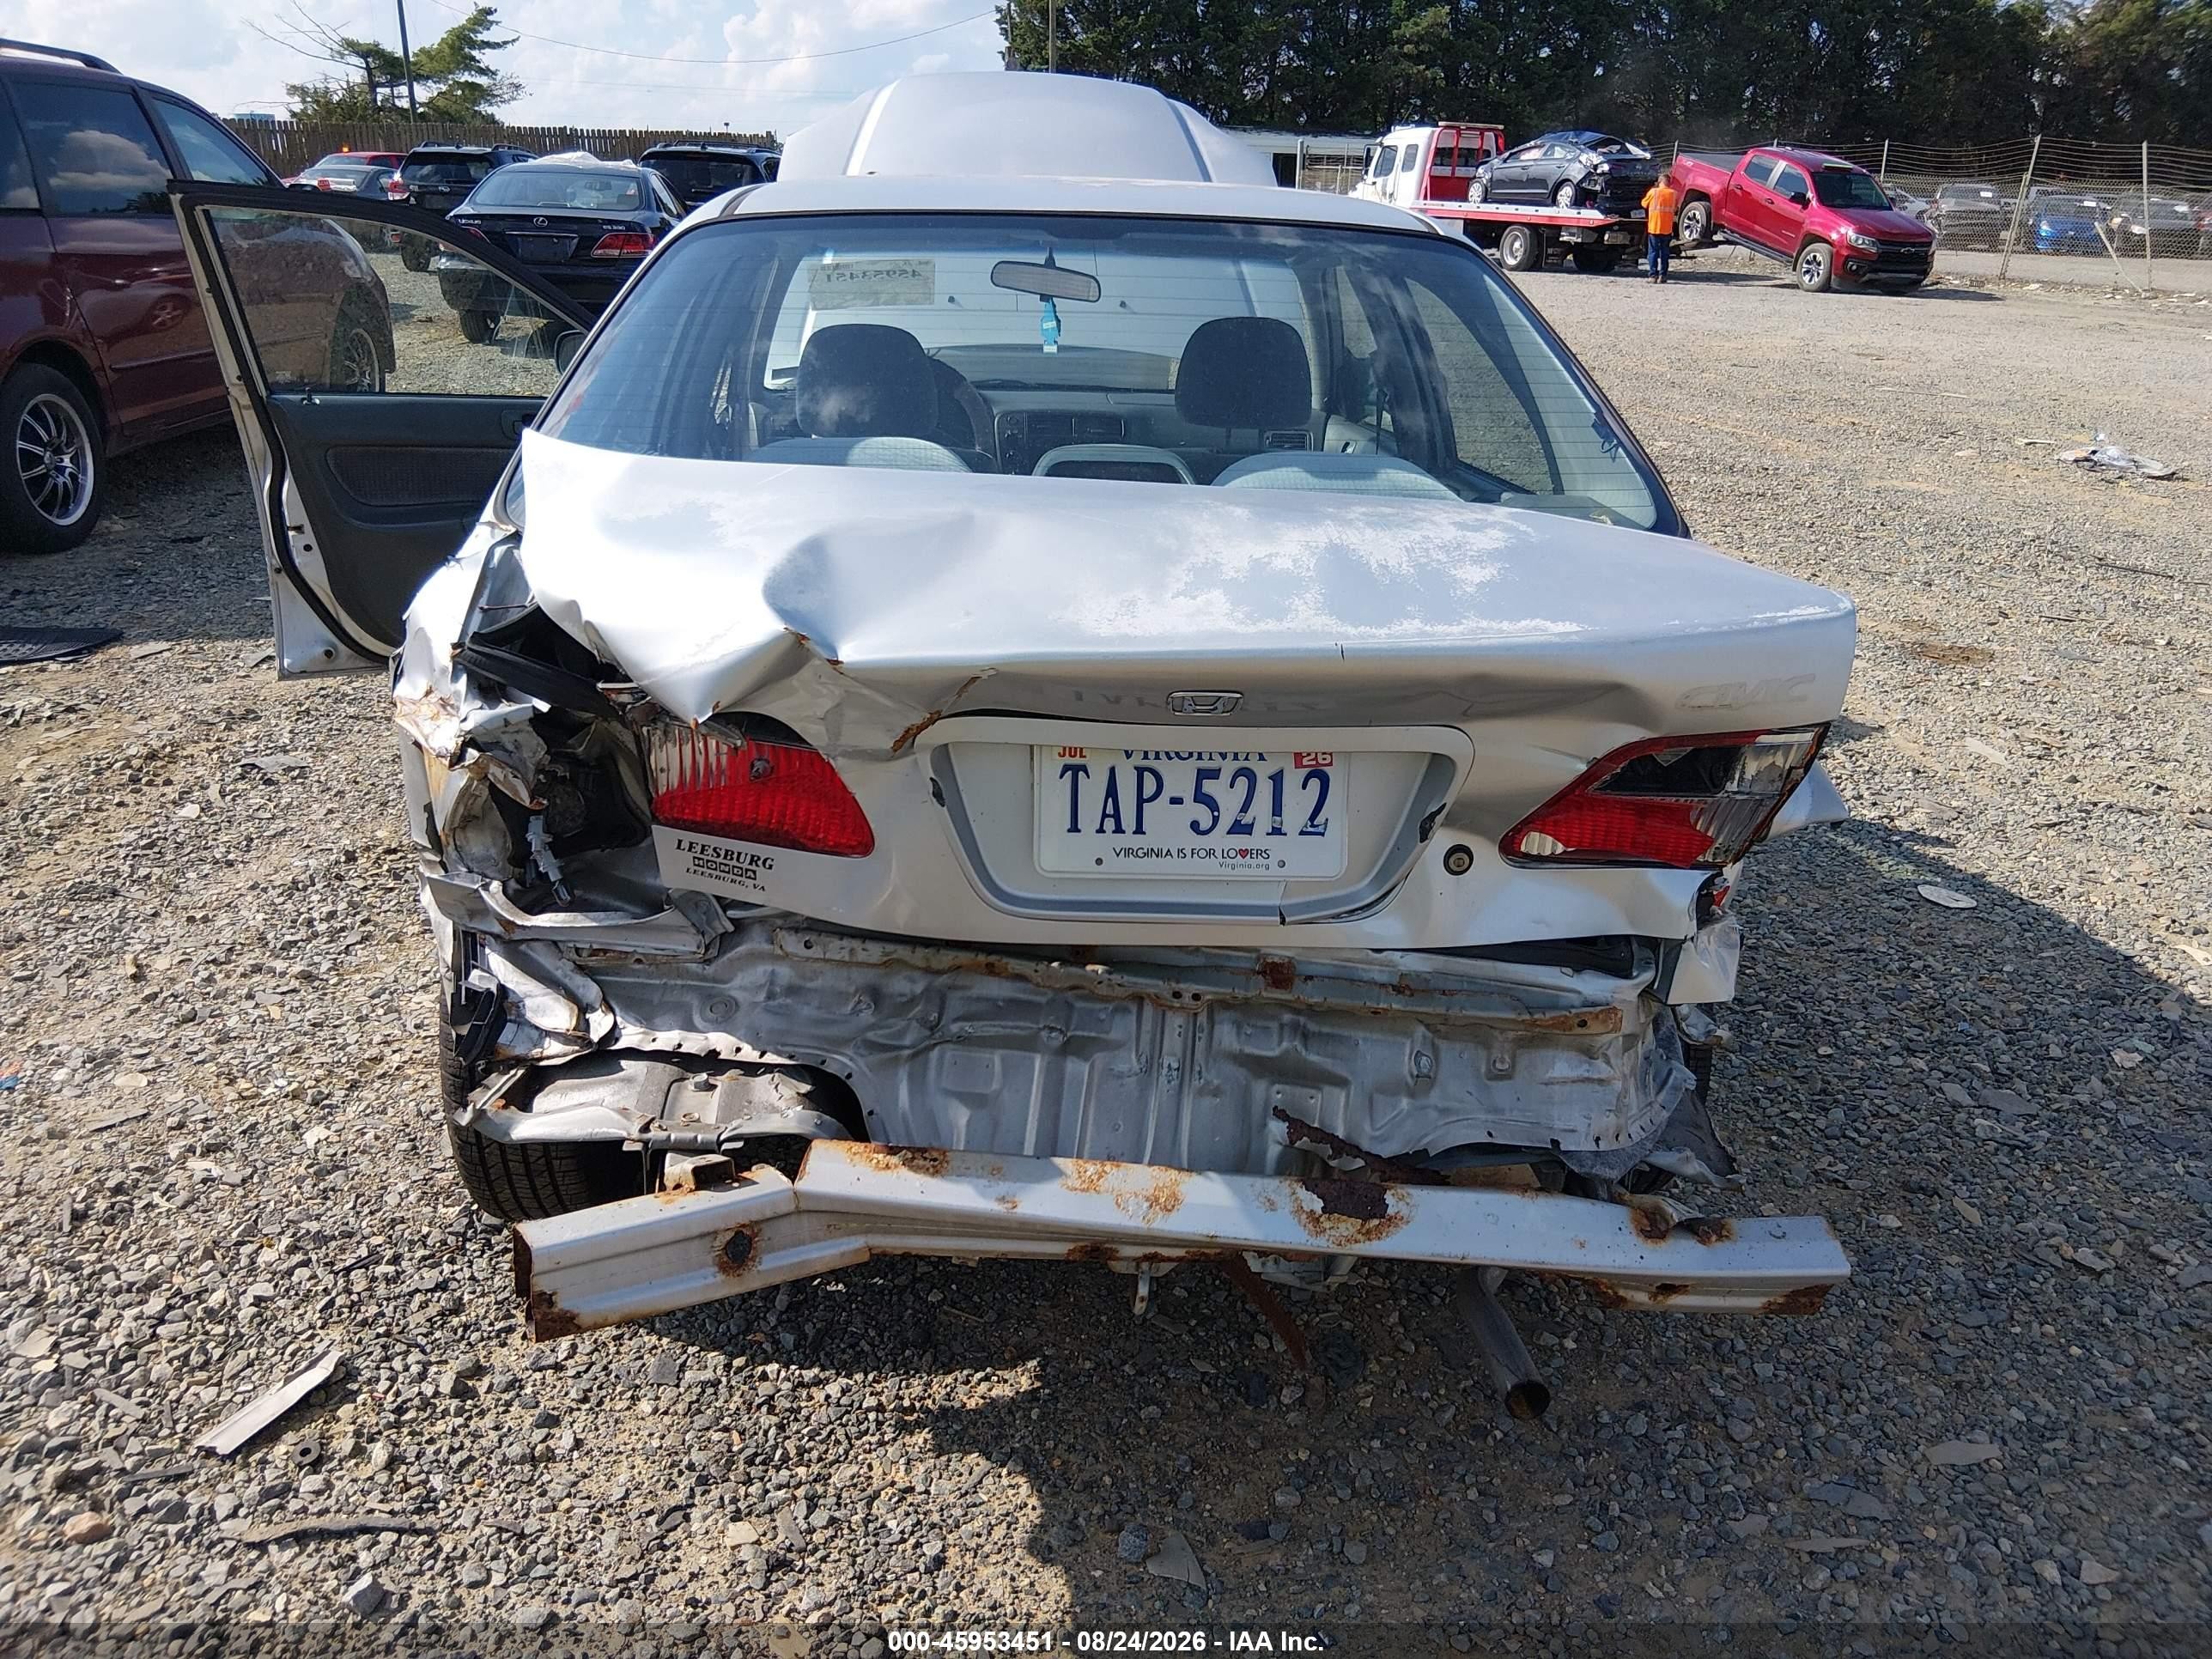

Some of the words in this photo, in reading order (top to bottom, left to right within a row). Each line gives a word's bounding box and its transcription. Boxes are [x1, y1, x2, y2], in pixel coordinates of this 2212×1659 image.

[1059, 763, 1331, 836] TAP-5212
[675, 838, 775, 871] LEESBURG
[1112, 847, 1174, 859] VIRGINIA
[1176, 847, 1187, 859] IS
[1190, 848, 1218, 860] FOR
[692, 856, 757, 880] HONDA
[1218, 861, 1271, 871] Virginia.org
[685, 867, 749, 889] LEESBURG,
[752, 884, 766, 892] VA
